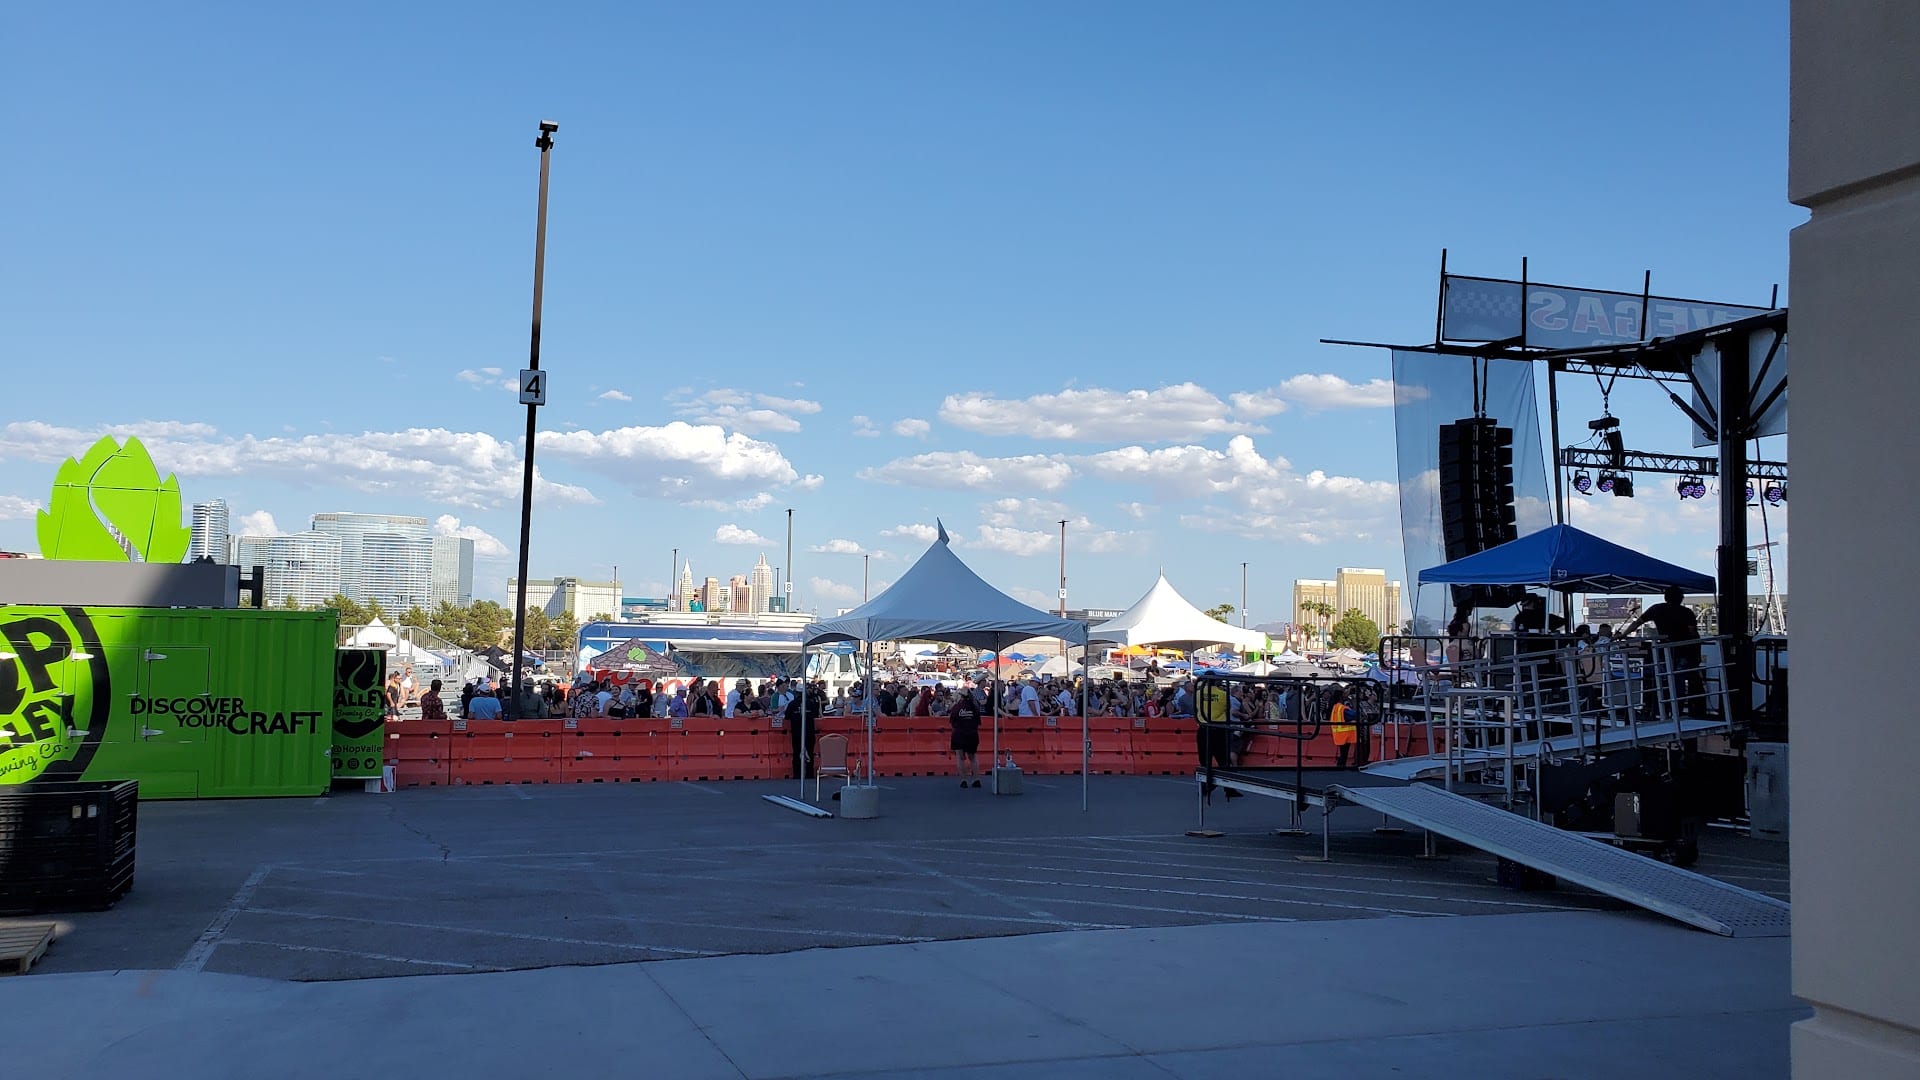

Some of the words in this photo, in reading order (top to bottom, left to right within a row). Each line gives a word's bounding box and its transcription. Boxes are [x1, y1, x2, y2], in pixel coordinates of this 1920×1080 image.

[525, 374, 541, 399] 4
[130, 697, 244, 715] DISCOVER
[176, 713, 228, 728] YOUR
[227, 711, 323, 735] CRAFT
[40, 743, 69, 759] Co.
[332, 744, 384, 754] @HopValle
